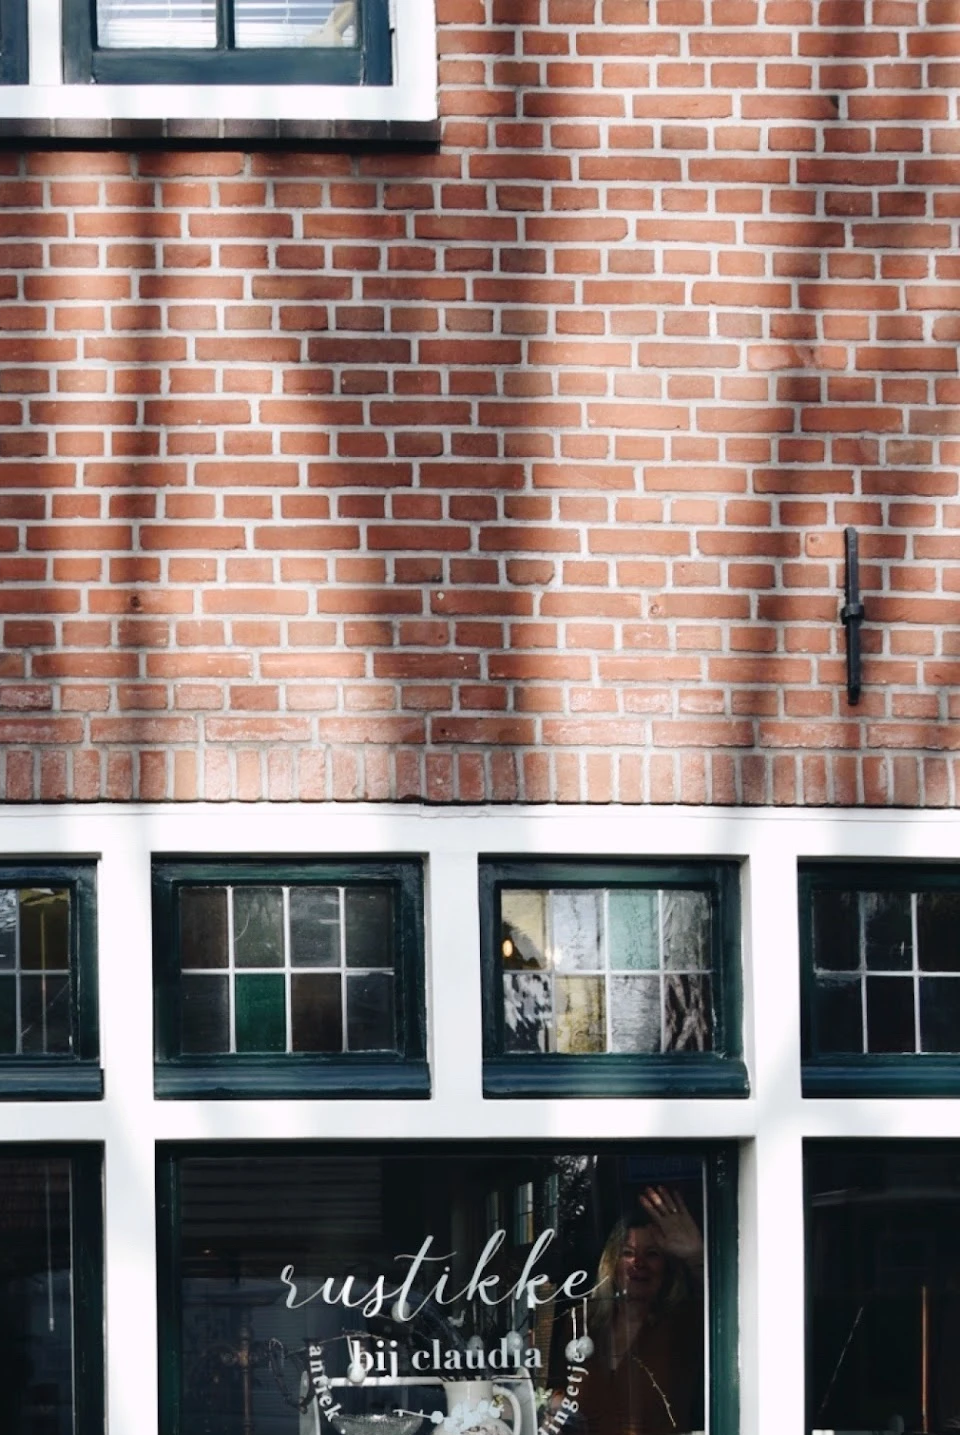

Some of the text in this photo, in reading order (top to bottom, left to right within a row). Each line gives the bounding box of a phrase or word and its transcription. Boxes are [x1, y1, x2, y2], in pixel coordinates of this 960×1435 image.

[281, 1229, 609, 1321] rustikke
[308, 1345, 342, 1423] antiek
[352, 1338, 542, 1384] bij claudia
